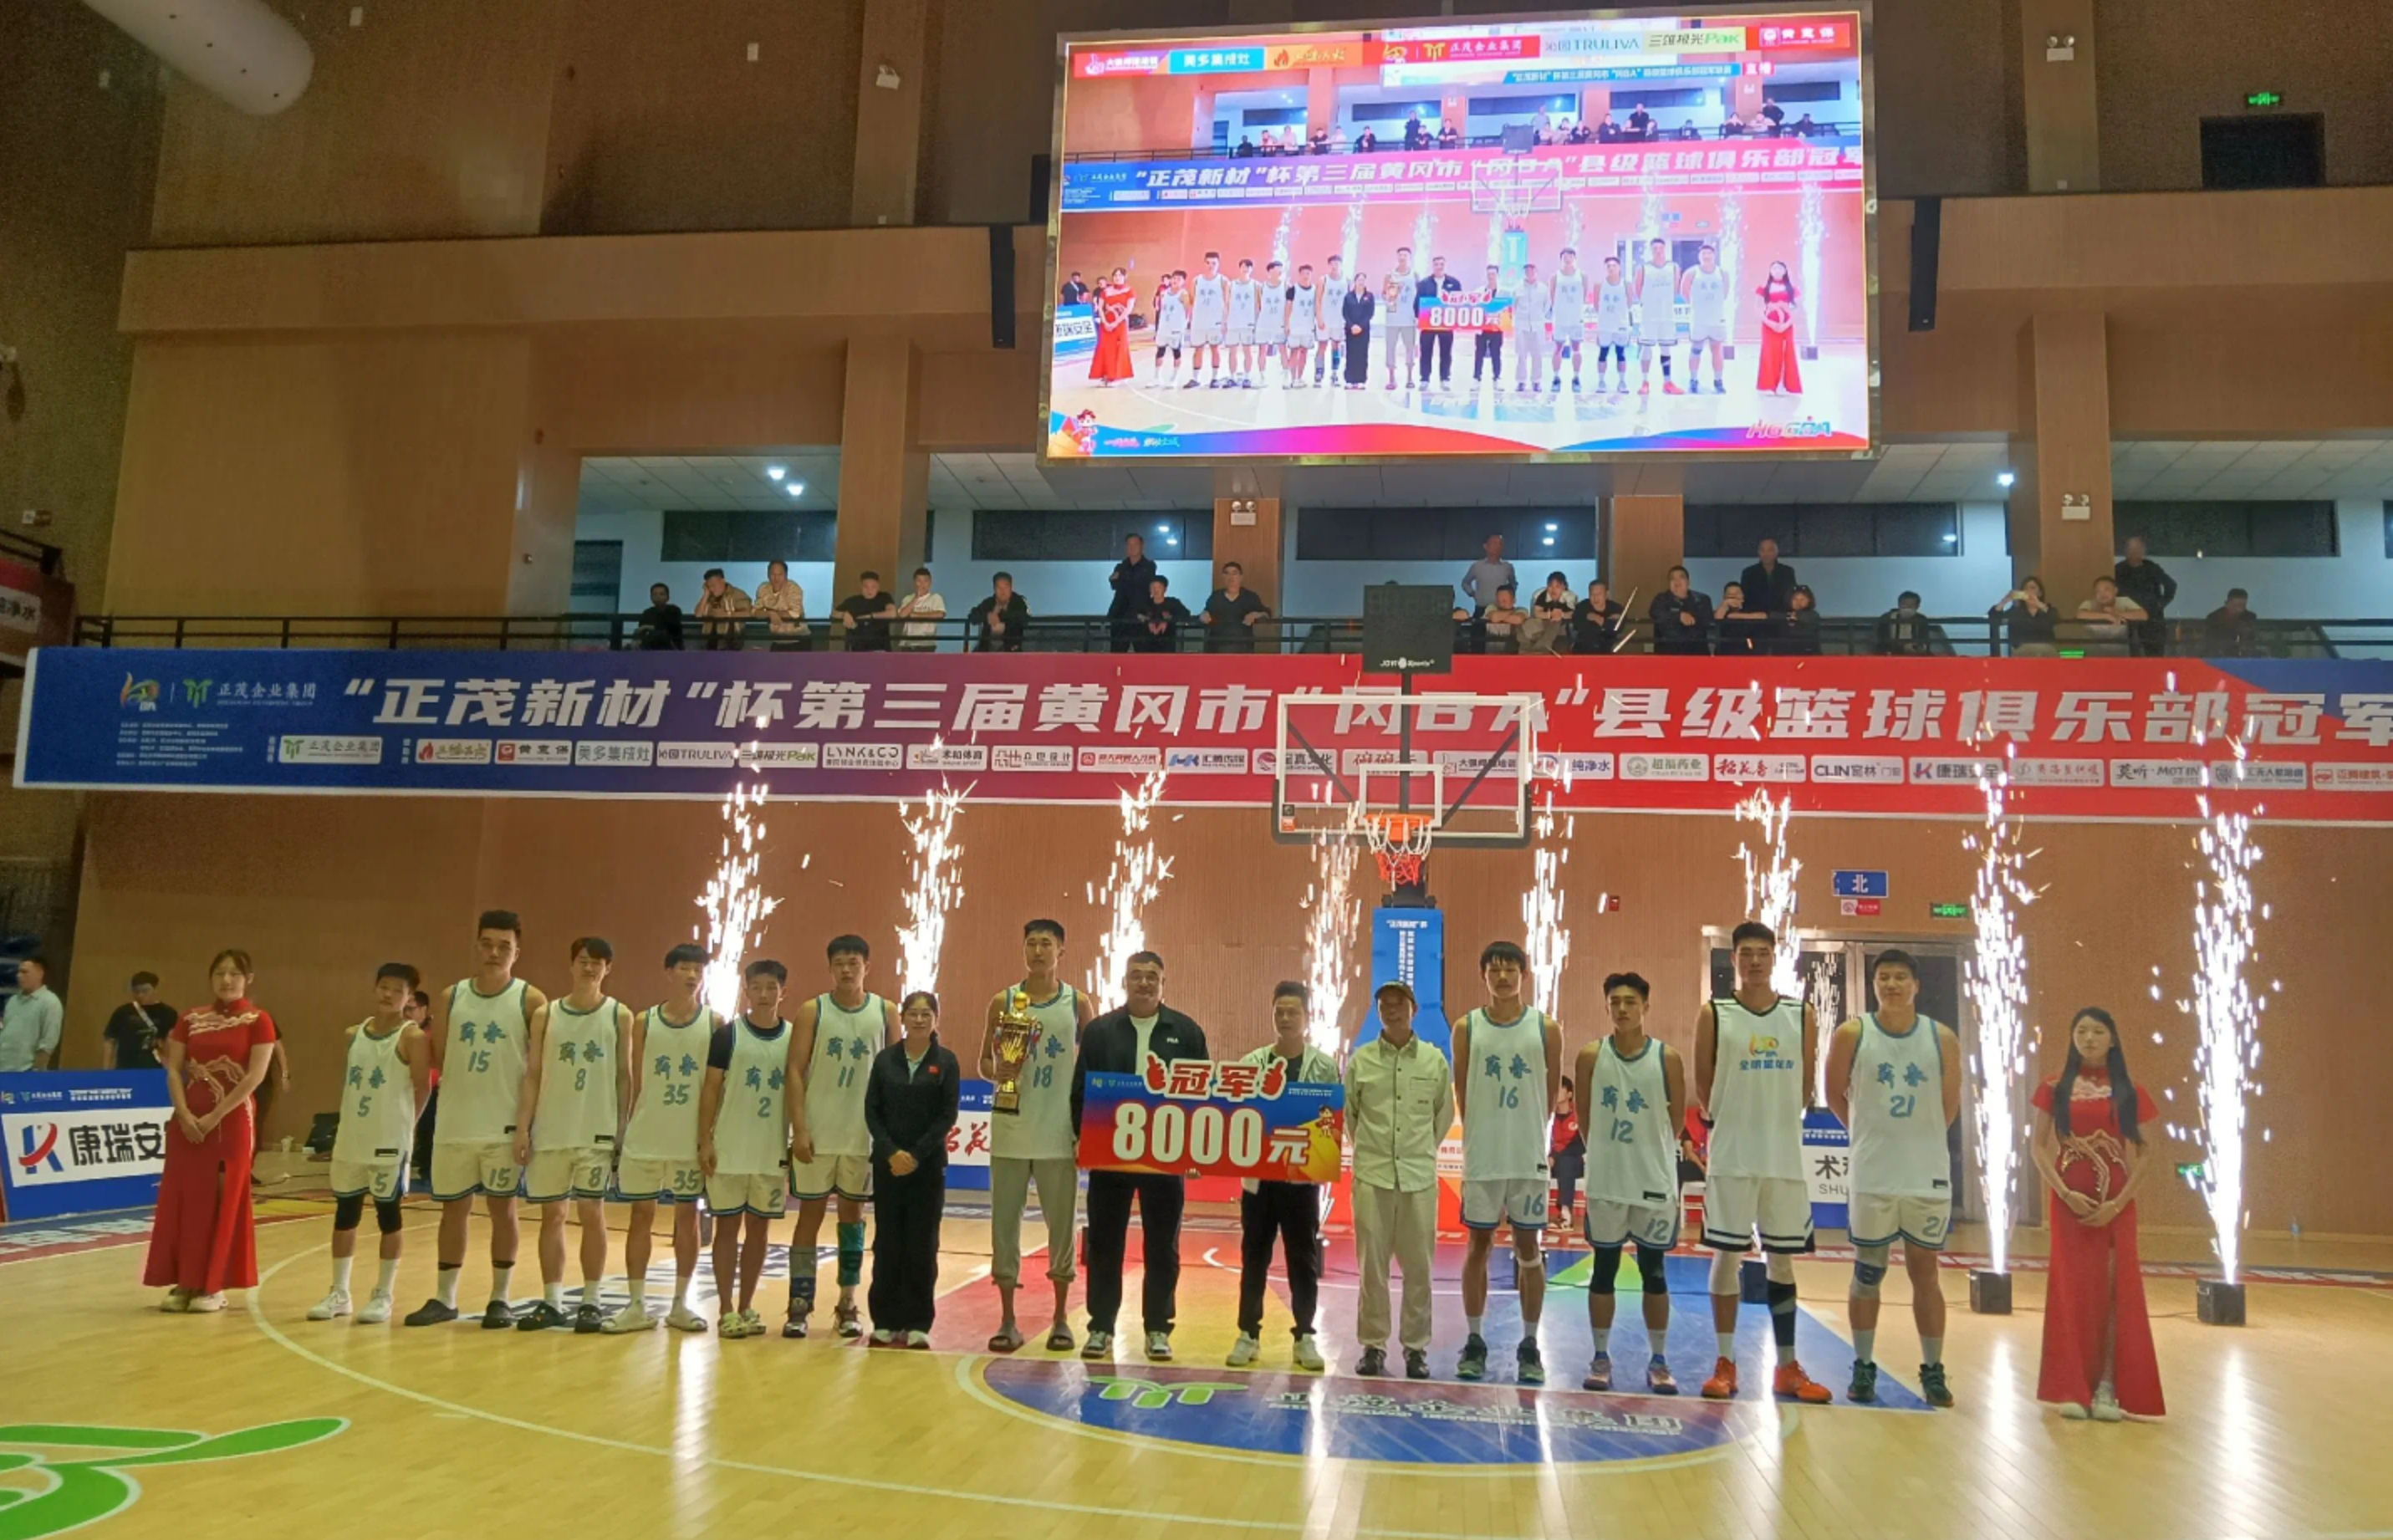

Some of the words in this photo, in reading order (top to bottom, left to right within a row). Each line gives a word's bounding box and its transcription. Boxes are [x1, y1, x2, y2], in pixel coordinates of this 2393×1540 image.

[217, 681, 317, 699] 正茂企业集团
[578, 745, 650, 762] 美多集成灶
[1572, 759, 1610, 772] 纯净水
[1716, 758, 1768, 778] 稻花香
[1851, 874, 1869, 893] 北
[468, 1050, 491, 1073] 15
[574, 1068, 588, 1091] 8
[837, 1067, 855, 1088] 11
[1033, 1065, 1053, 1088] 18
[1168, 1063, 1259, 1098] 冠军
[663, 1084, 691, 1105] 35
[1499, 1086, 1519, 1109] 16
[357, 1096, 371, 1118] 5
[757, 1097, 772, 1118] 2
[1889, 1094, 1916, 1119] 21
[1610, 1118, 1634, 1144] 12
[69, 1121, 172, 1166] 康瑞安
[374, 1172, 388, 1193] 5
[488, 1168, 510, 1188] 15
[588, 1166, 602, 1188] 8
[672, 1170, 701, 1191] 35
[768, 1188, 782, 1208] 2
[1523, 1194, 1545, 1216] 16
[1644, 1217, 1671, 1242] 12
[1922, 1216, 1947, 1238] 21
